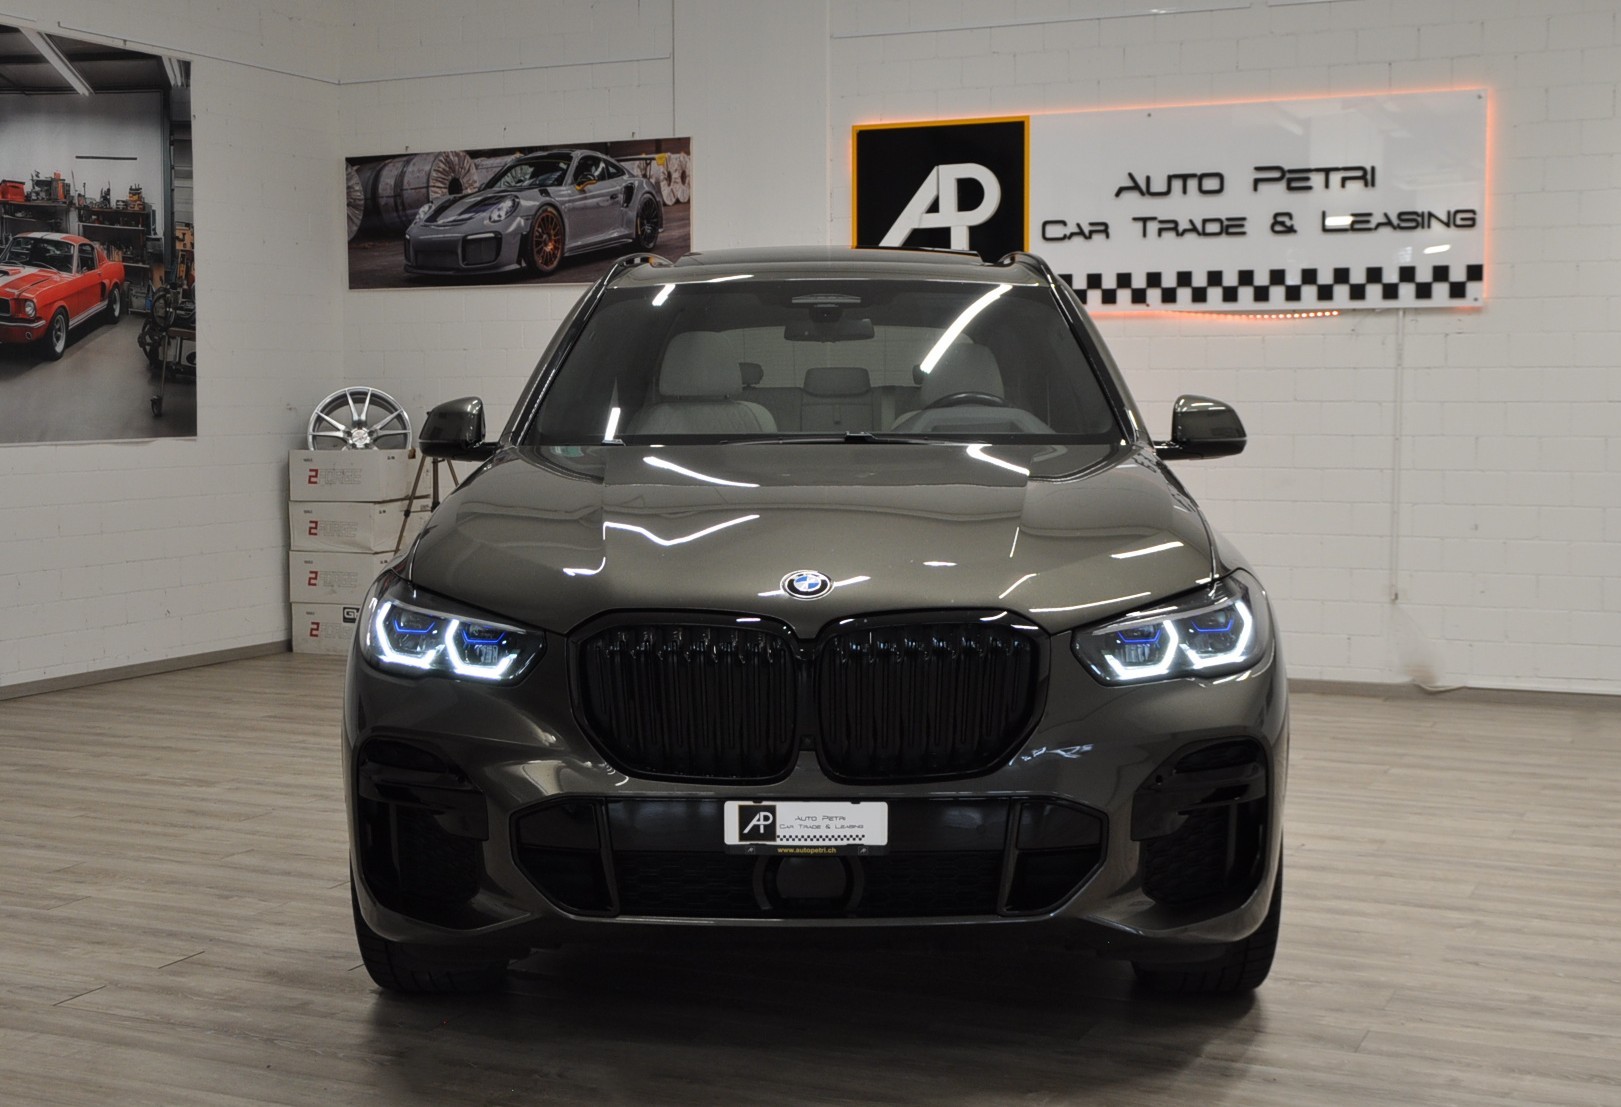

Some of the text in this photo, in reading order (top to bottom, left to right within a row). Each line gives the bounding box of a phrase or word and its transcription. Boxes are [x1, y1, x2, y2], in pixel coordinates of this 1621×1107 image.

[1114, 165, 1376, 198] AUTO PETRI
[879, 162, 1002, 249] AP
[1041, 209, 1477, 242] CAR TRADE & LEASING
[742, 811, 774, 834] AP
[777, 846, 837, 854] www.autopetri.ch
